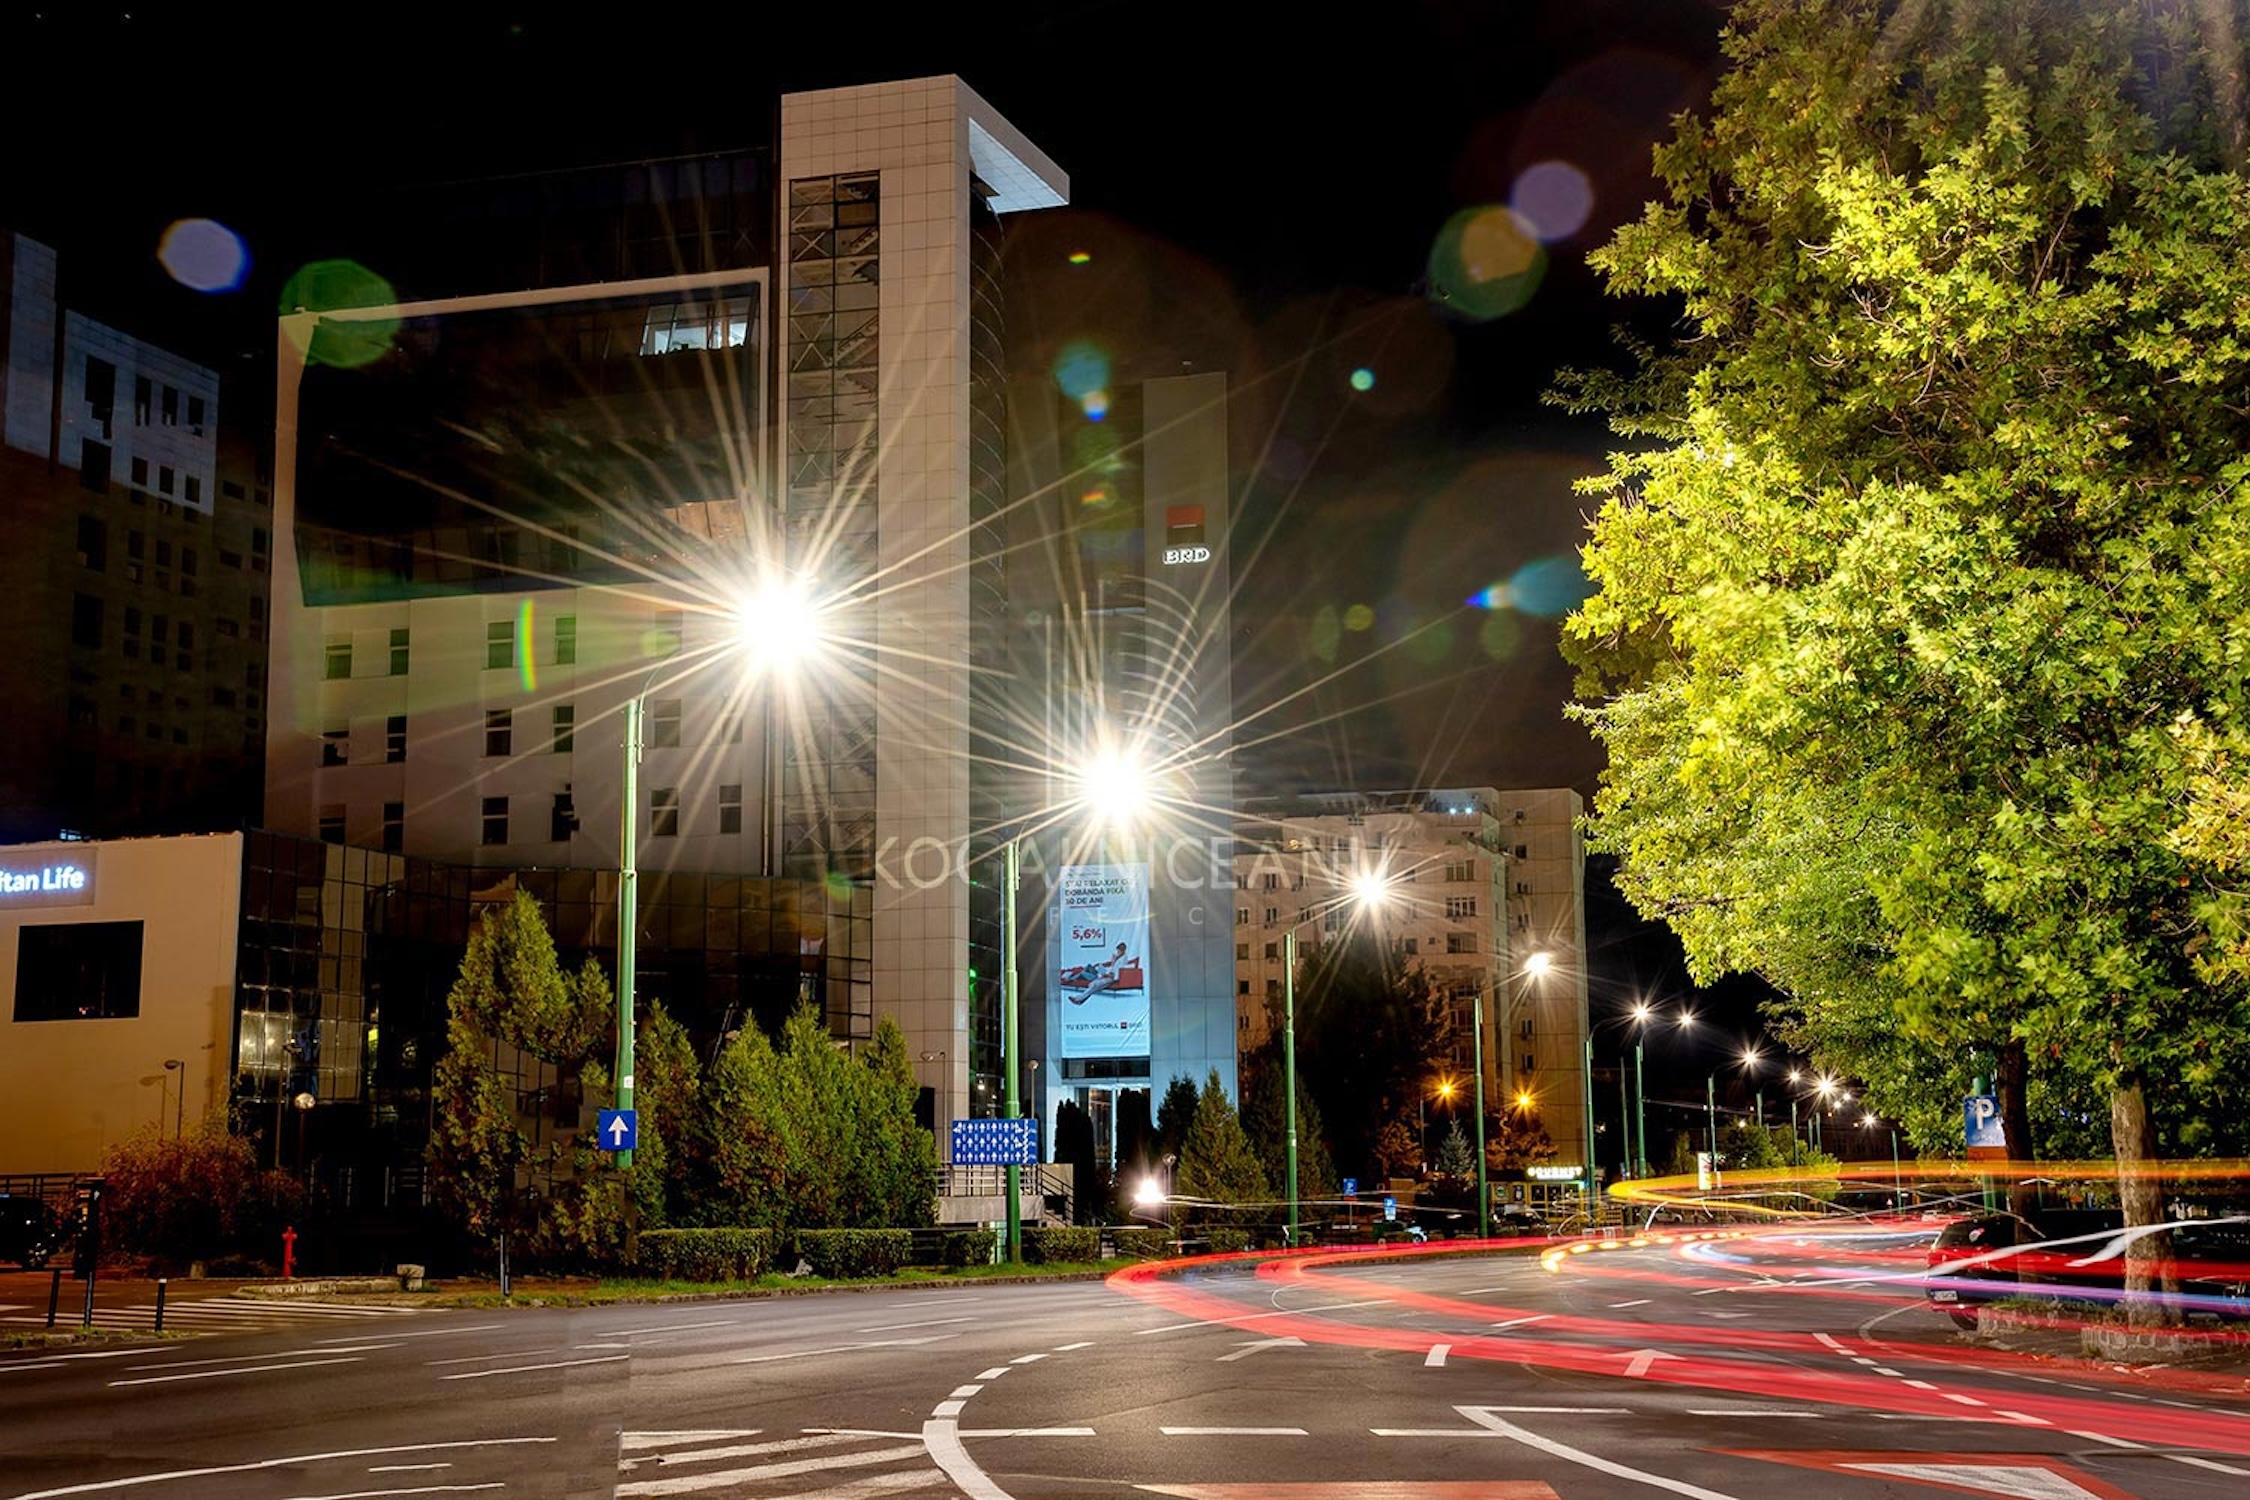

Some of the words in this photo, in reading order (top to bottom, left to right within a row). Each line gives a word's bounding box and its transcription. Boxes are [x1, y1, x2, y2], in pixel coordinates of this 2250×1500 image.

[1162, 547, 1210, 564] BRD
[42, 866, 85, 891] Life
[1077, 896, 1087, 904] DE
[1089, 896, 1104, 904] ANI
[1072, 928, 1102, 941] 5,6%
[1976, 1098, 1995, 1130] P
